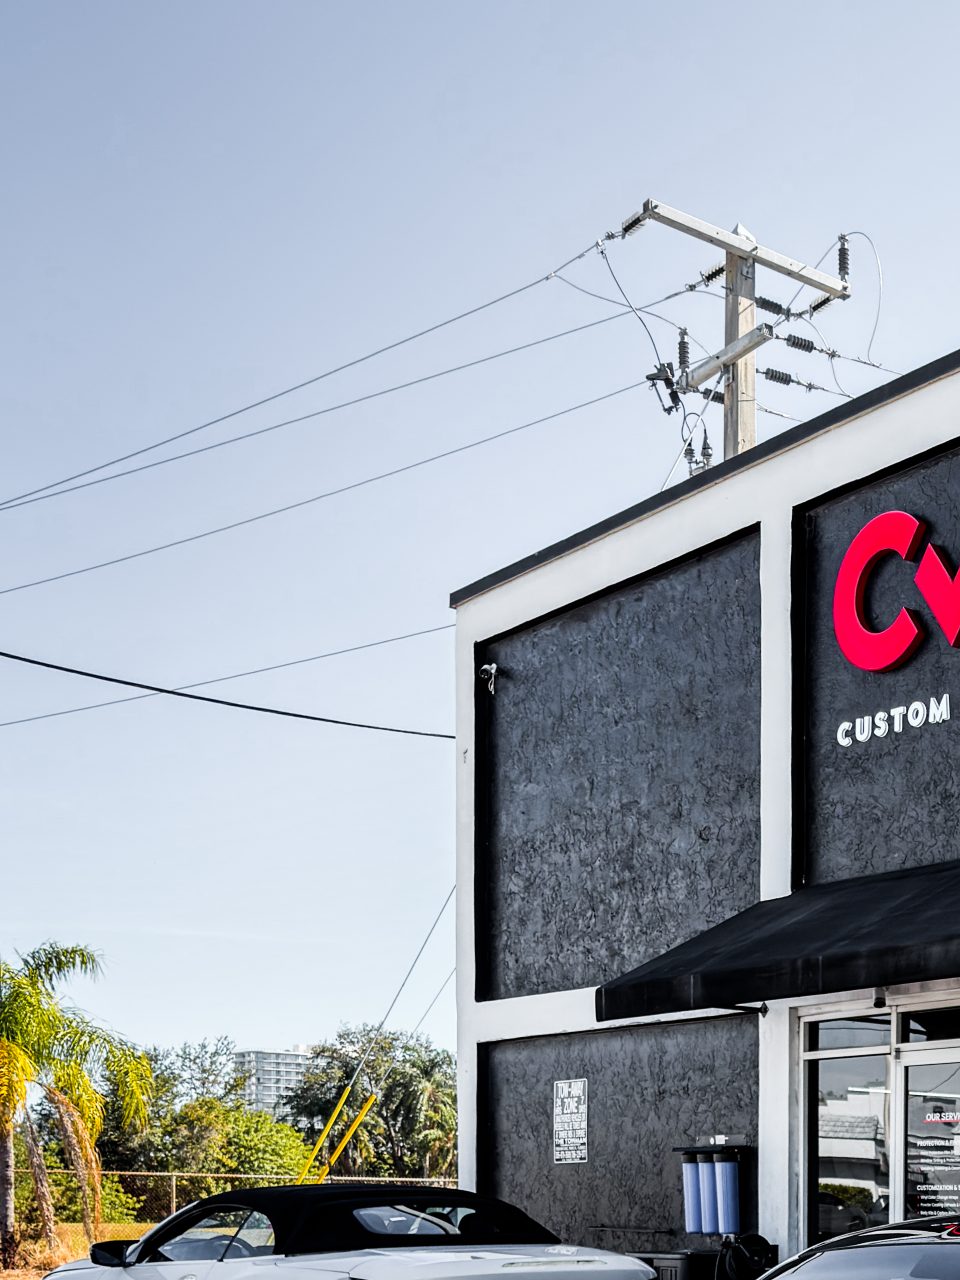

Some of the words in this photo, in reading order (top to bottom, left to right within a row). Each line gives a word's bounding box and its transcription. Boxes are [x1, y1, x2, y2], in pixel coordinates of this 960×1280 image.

[836, 694, 951, 748] CUSTOM
[563, 1097, 578, 1113] ZONE
[926, 1112, 940, 1121] OUR
